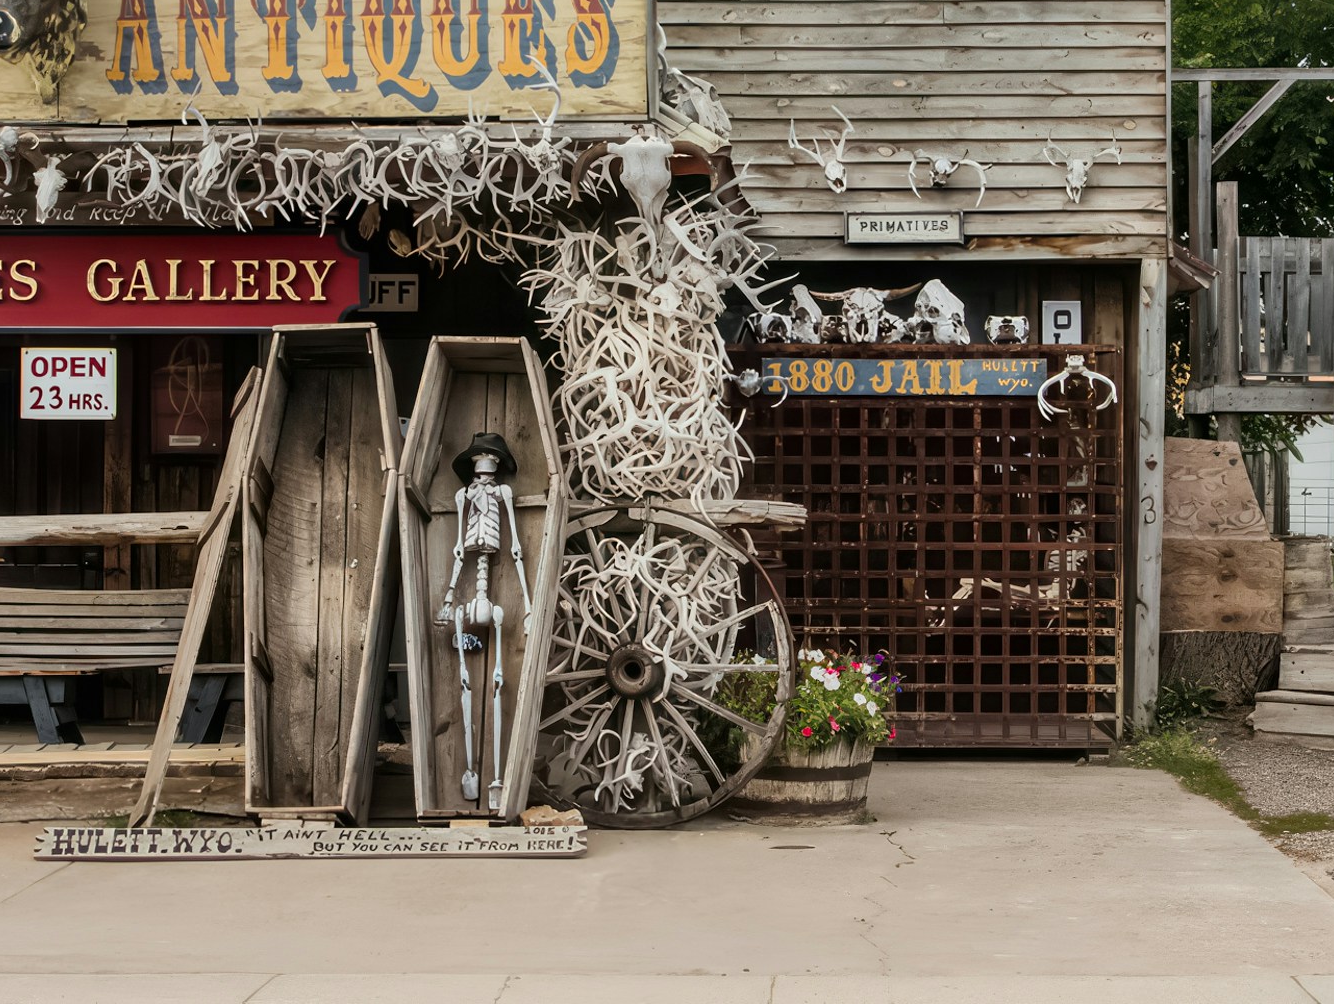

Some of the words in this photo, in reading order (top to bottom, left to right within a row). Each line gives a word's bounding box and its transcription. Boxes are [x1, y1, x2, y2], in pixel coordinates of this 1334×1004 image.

[860, 220, 949, 233] PRIMATIVES
[86, 258, 337, 302] GALLERY
[30, 356, 106, 377] OPEN
[767, 360, 856, 393] 1880
[869, 360, 978, 394] JAIL
[29, 385, 63, 409] 23
[68, 393, 109, 411] HRS.
[172, 829, 243, 853] WYO.
[313, 841, 344, 852] BUT
[352, 841, 378, 852] YOU
[383, 842, 414, 852] CAN
[420, 842, 448, 852] SEE
[479, 840, 519, 851] FROM
